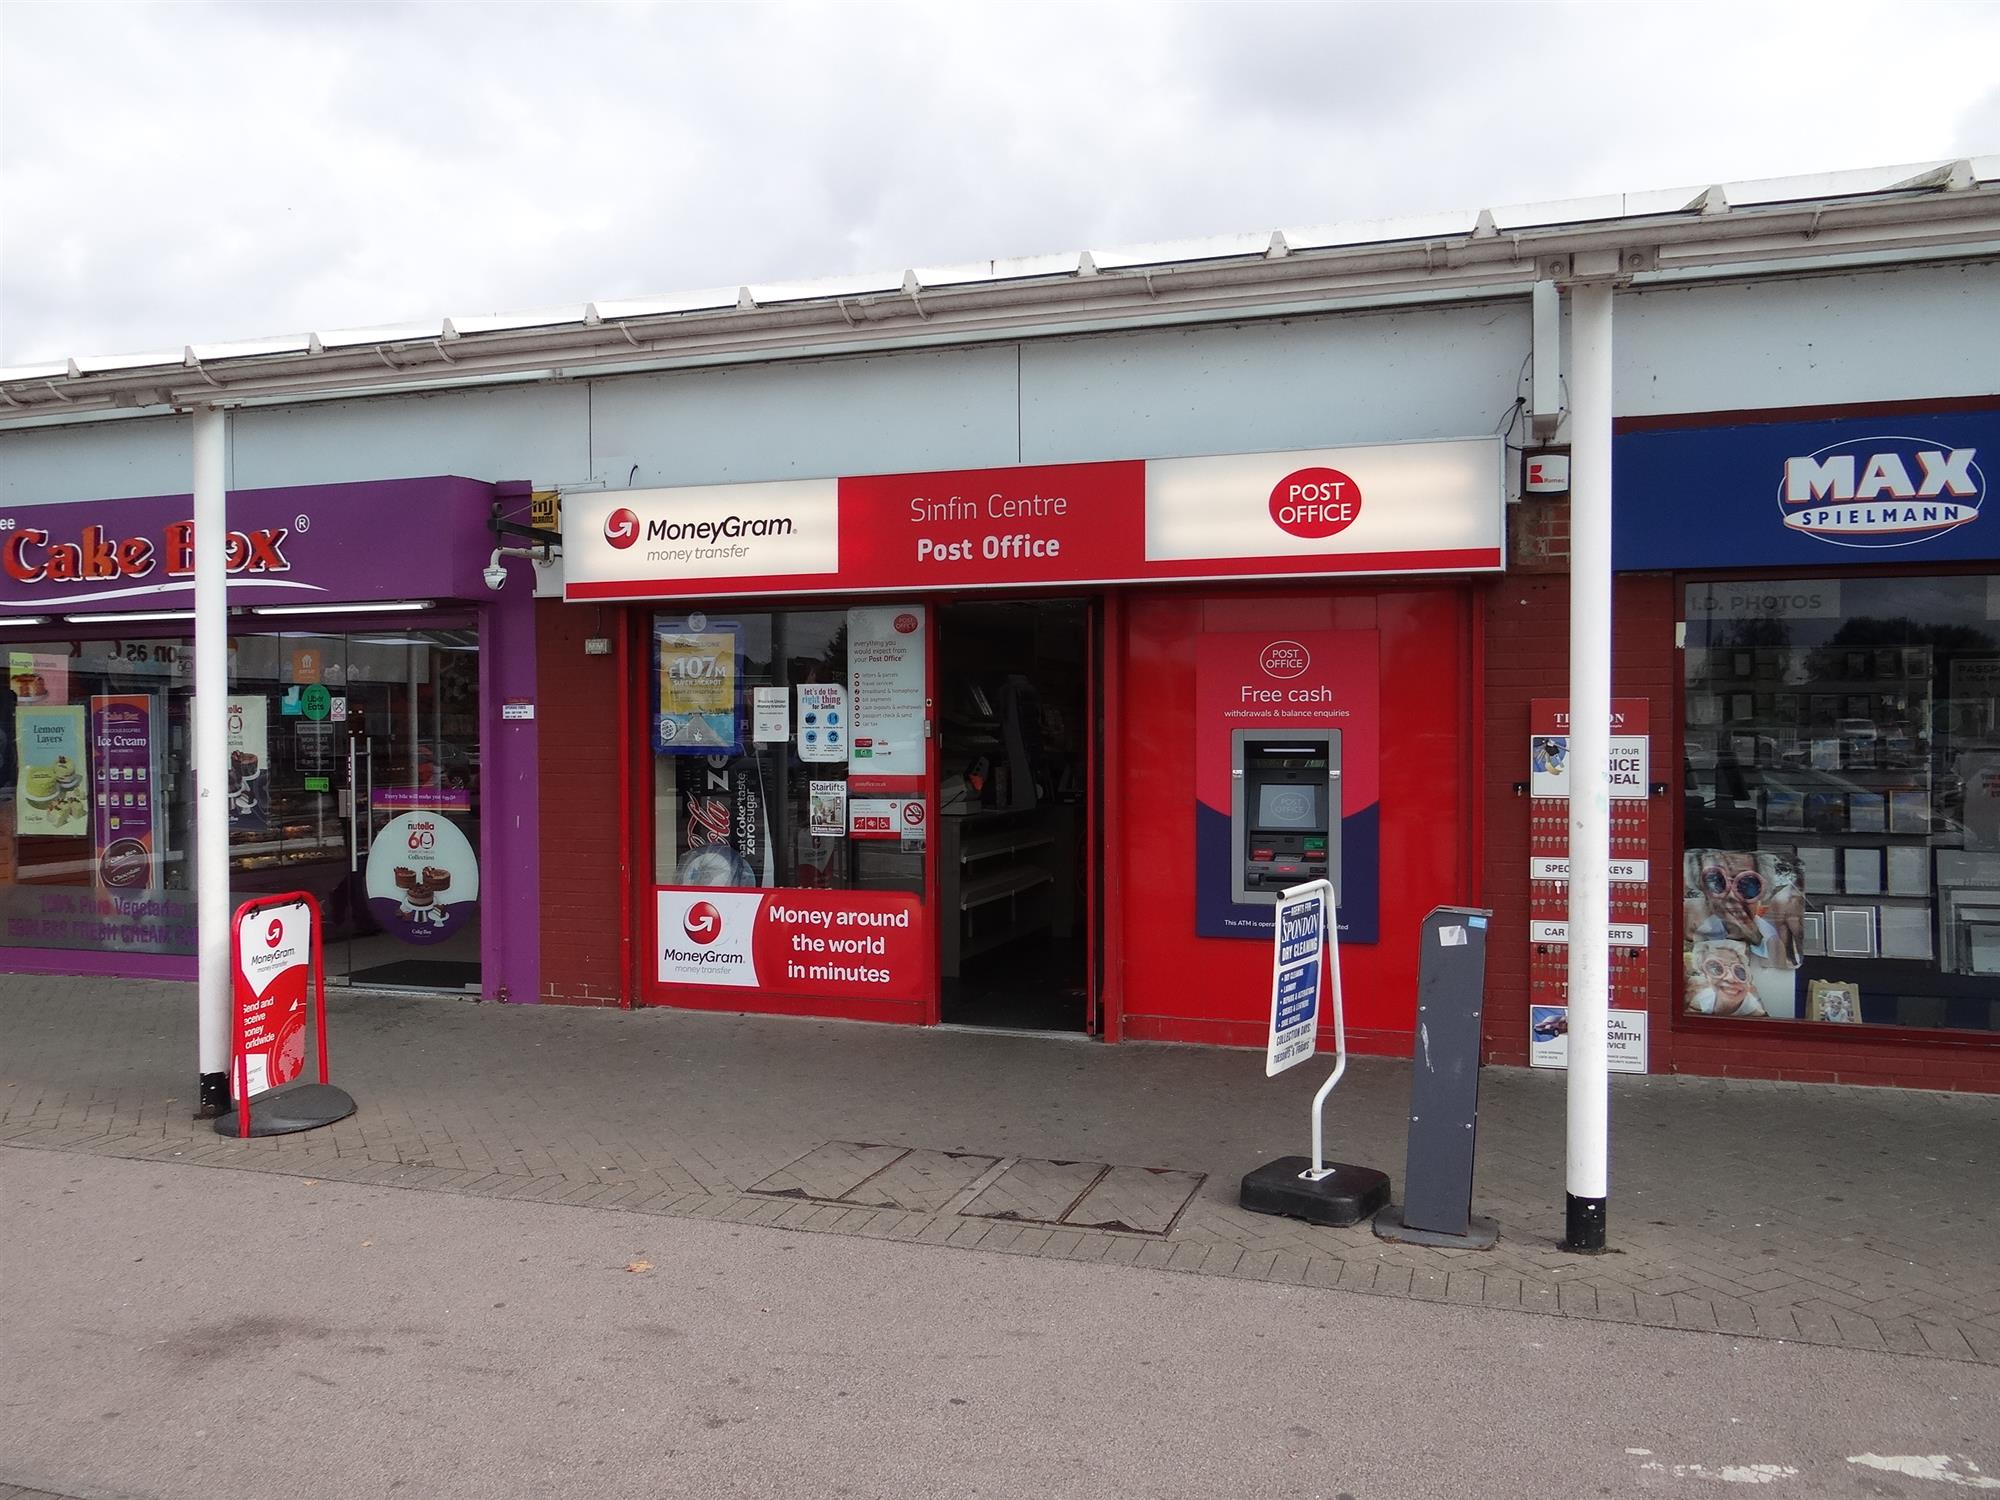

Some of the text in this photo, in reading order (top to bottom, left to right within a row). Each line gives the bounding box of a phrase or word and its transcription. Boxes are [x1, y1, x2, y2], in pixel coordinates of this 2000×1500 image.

[1784, 448, 1978, 504] MAX
[1289, 481, 1345, 503] POST
[911, 493, 1067, 522] Sinfin Centre
[1278, 503, 1351, 524] OFFICE
[1802, 506, 1959, 526] SPIELMANN
[647, 515, 793, 544] MoneyGram
[3, 525, 156, 583] Cake
[647, 544, 750, 563] money transfer
[917, 533, 1060, 562] Post Office
[1731, 594, 1822, 611] PHOTOS
[854, 640, 884, 648] everything
[1265, 659, 1303, 668] OFFICE
[1272, 650, 1299, 659] POST
[802, 695, 841, 705] right thing
[828, 687, 838, 695] the
[1241, 685, 1332, 703] Free cash
[1224, 710, 1272, 718] withdrawals
[1281, 710, 1312, 718] balance
[1313, 710, 1350, 719] enquiries
[1554, 713, 1625, 723] TION
[33, 725, 65, 736] Lemony
[36, 735, 63, 746] Layers
[97, 735, 147, 747] Ice Cream
[737, 772, 746, 802] taste
[811, 783, 844, 791] Stairlifts
[747, 789, 758, 822] sugar
[407, 821, 435, 830] nutella
[737, 805, 747, 837] Coke
[747, 821, 756, 855] zero
[769, 906, 909, 928] Money around
[1282, 913, 1320, 943] SPONDON
[1545, 928, 1633, 939] CAR ERTS
[792, 934, 885, 954] the world
[1282, 937, 1317, 961] DRY CLEANING
[251, 947, 295, 965] MoneyGram
[664, 949, 743, 965] MoneyGram
[674, 966, 731, 975] money transfer
[788, 960, 890, 983] in minutes
[260, 996, 274, 1009] and
[244, 1012, 266, 1026] eceive
[1608, 1019, 1627, 1029] CAL
[244, 1025, 264, 1037] oney
[1276, 1028, 1300, 1046] COLLECTION
[245, 1032, 275, 1050] orldwide
[1274, 1048, 1291, 1064] TUESDAYS
[1295, 1041, 1310, 1055] FRIDAYS
